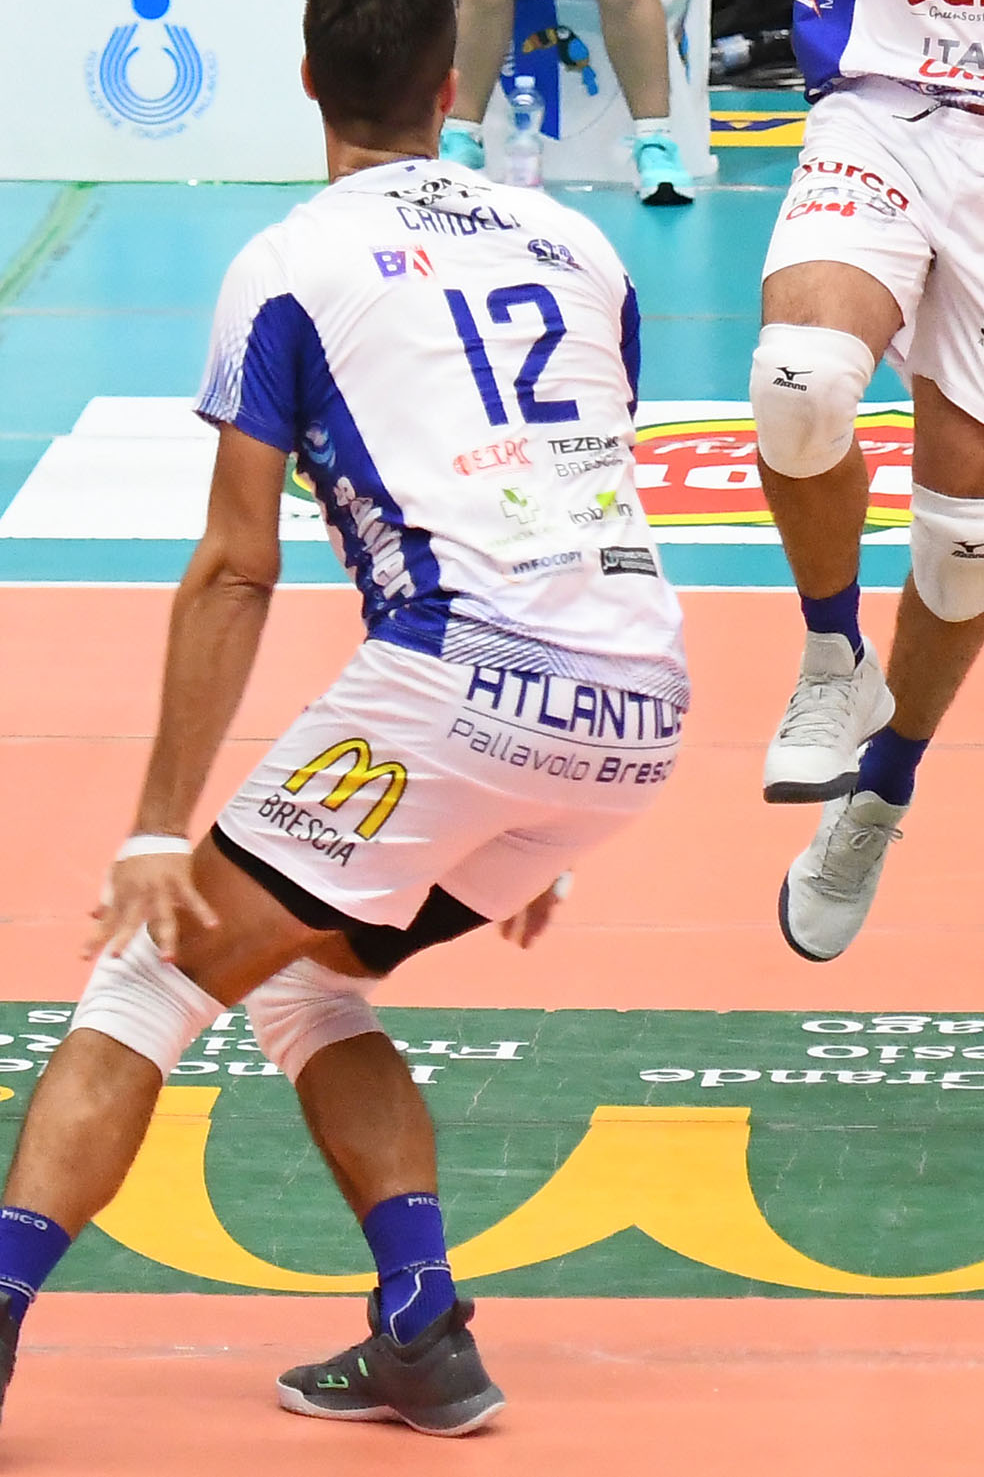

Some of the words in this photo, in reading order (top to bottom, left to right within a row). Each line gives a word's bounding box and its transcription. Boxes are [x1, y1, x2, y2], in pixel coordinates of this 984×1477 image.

[444, 282, 579, 427] 12
[447, 718, 591, 781] Pallavolo
[258, 794, 357, 868] BRESCIA
[1, 1209, 48, 1231] MICO
[408, 1197, 442, 1211] MIC
